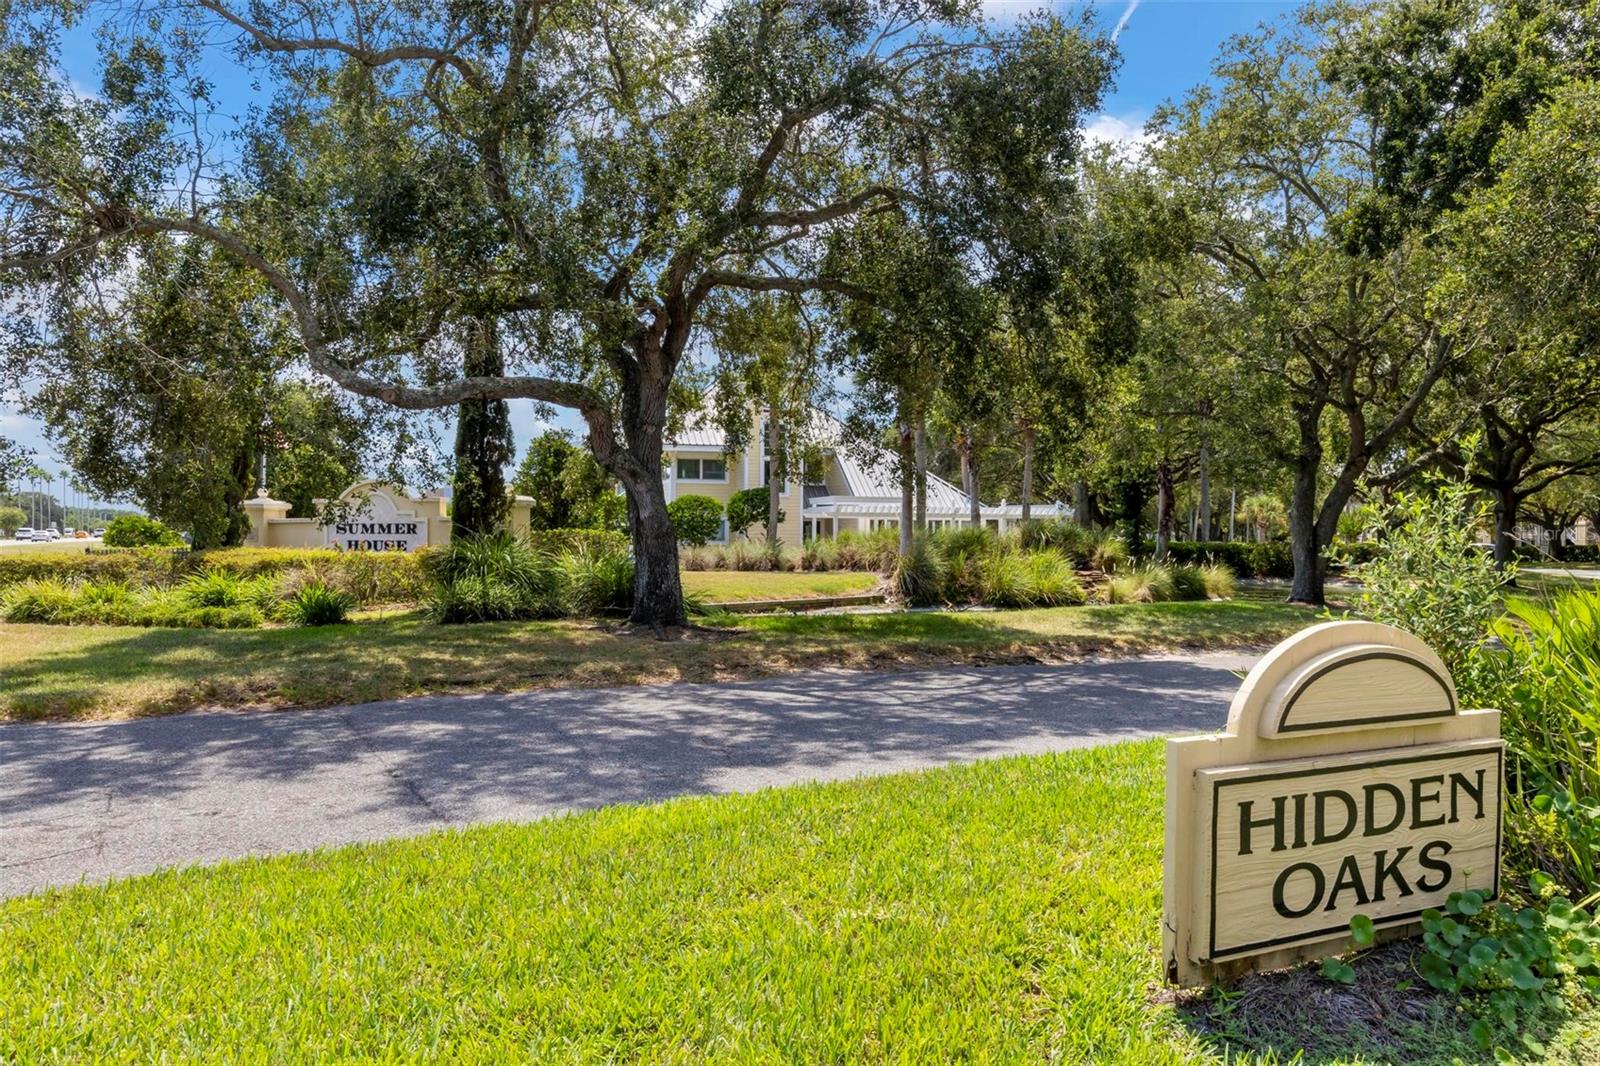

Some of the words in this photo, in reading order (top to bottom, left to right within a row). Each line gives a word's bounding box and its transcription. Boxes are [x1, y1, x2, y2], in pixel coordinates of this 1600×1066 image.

[336, 523, 417, 535] SUMMER
[347, 540, 408, 552] HOUSE
[1237, 769, 1486, 856] HIDDEN
[1272, 840, 1453, 919] OAKS
